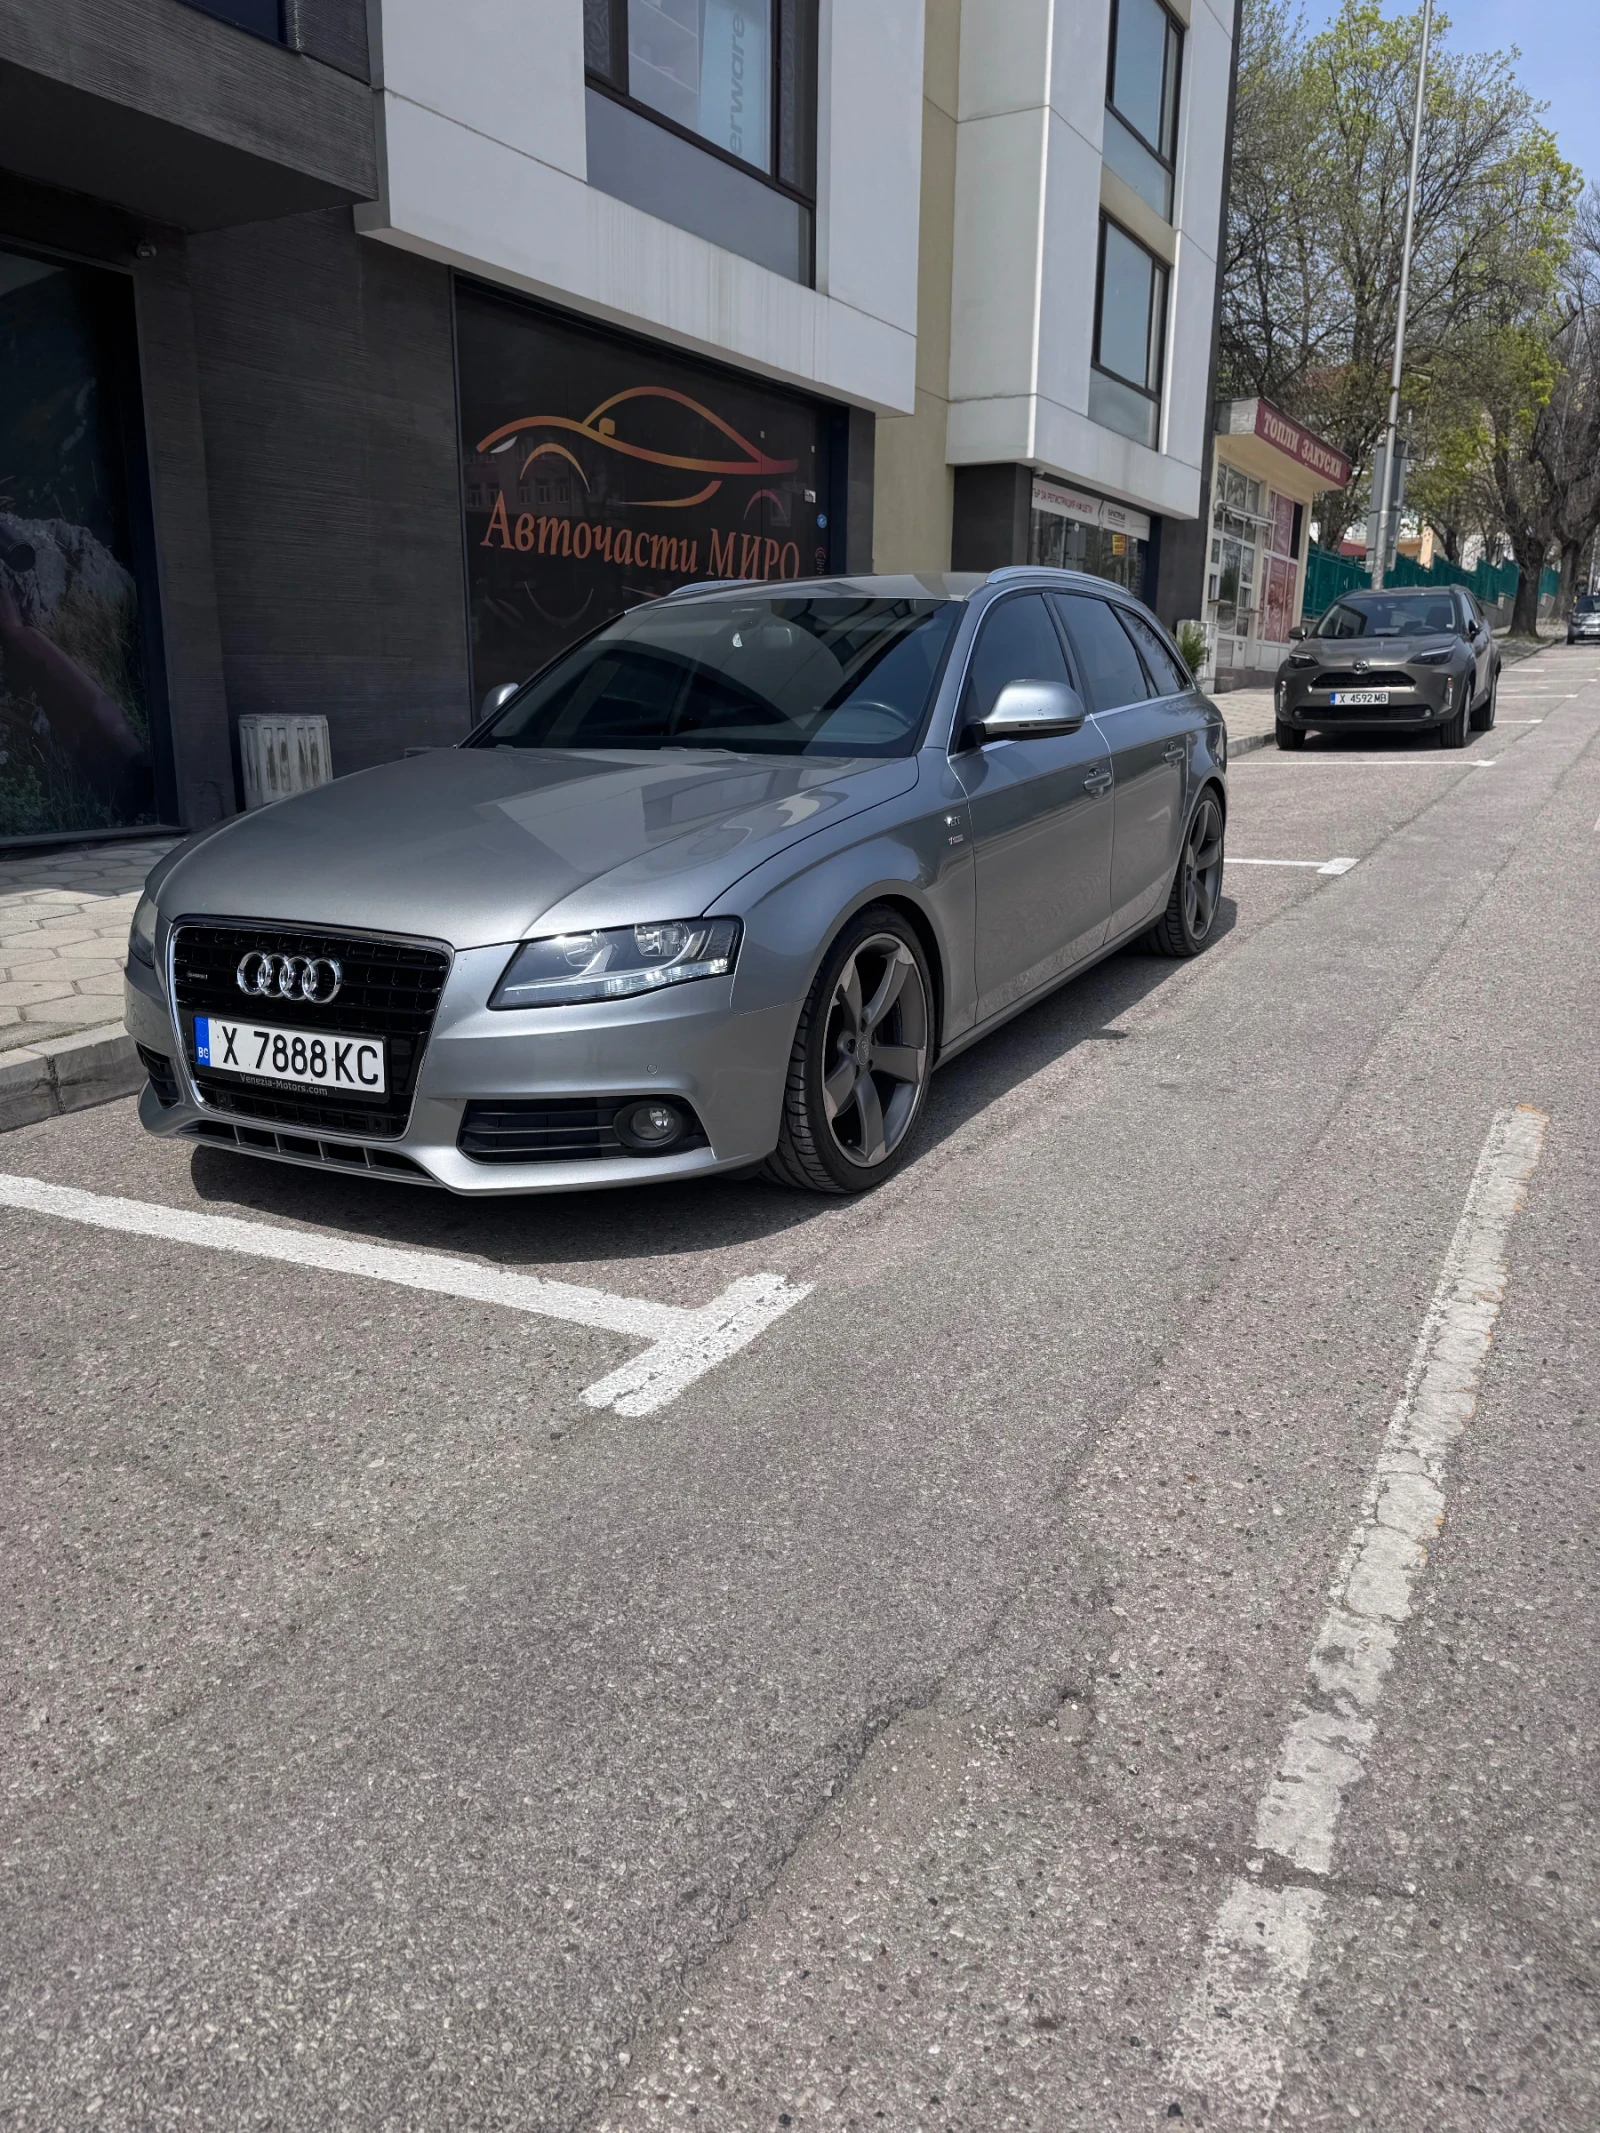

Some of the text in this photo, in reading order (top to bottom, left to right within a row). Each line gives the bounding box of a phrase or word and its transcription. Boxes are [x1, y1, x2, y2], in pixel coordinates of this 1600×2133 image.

[1263, 411, 1343, 479] ТОПЛИ ЗАКУСКИ
[480, 489, 800, 580] Авточасти МИРО
[1340, 694, 1346, 703] X
[198, 1046, 210, 1059] BG
[222, 1026, 239, 1066] X
[240, 1073, 328, 1096] Venezia-Motors.com
